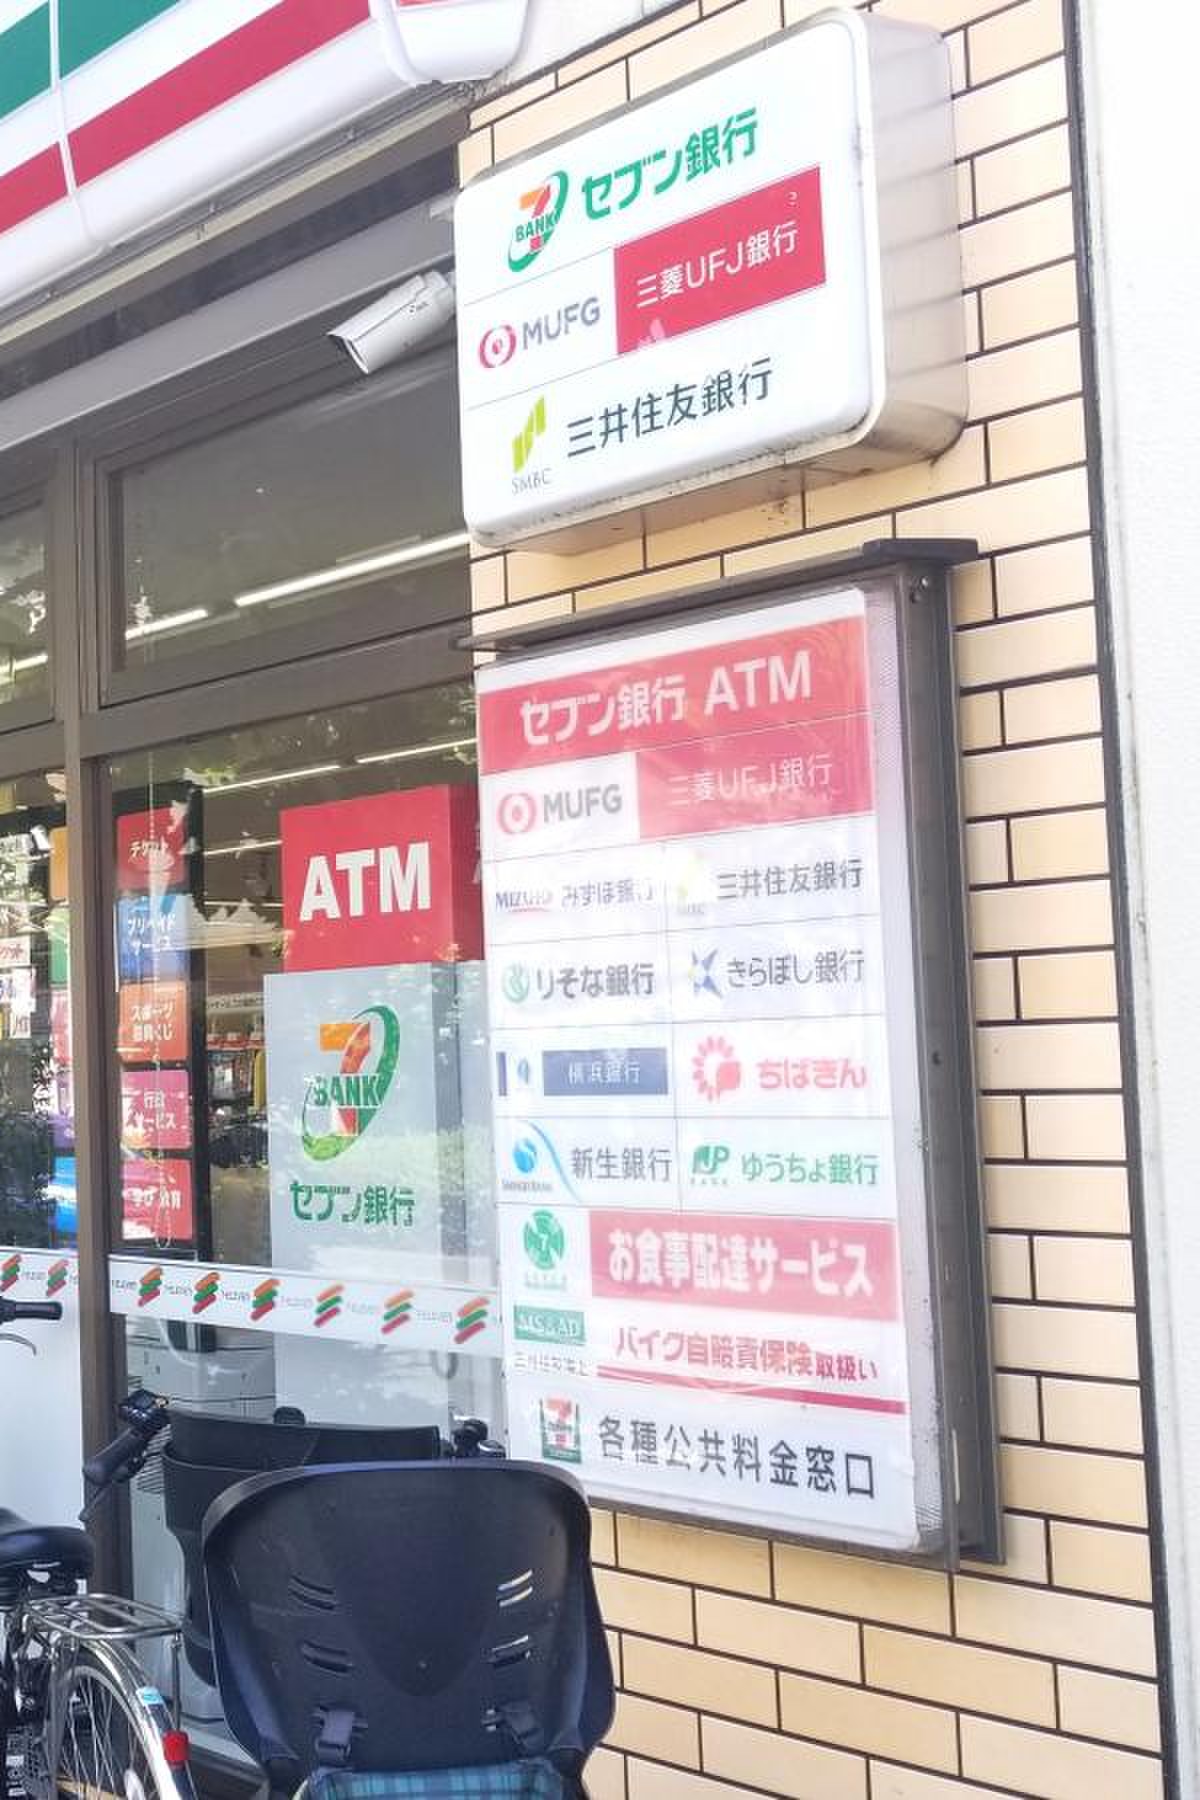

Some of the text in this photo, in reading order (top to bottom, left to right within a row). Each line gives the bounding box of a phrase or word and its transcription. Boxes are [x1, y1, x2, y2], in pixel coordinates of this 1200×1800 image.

[582, 107, 758, 221] セブン銀行
[516, 211, 558, 243] BANK
[637, 221, 799, 308] 三菱UFJ銀行
[522, 297, 601, 351] MUFG
[567, 357, 775, 458] 三井住友銀行
[511, 467, 553, 495] SMBC
[520, 650, 811, 746] セブン銀行 ATM
[667, 753, 832, 806] 三菱UFJ銀行
[543, 783, 623, 824] MUFG
[299, 841, 432, 923] ATM
[717, 859, 863, 900] 三井住友銀行
[535, 963, 655, 1000] りそな銀行
[727, 949, 865, 989] きらぼし銀行
[312, 1075, 381, 1107] BANK
[568, 1060, 641, 1085] 横浜銀行
[571, 1146, 673, 1183] 新生銀行
[741, 1151, 879, 1186] ゆうちょ銀行
[289, 1180, 415, 1227] セブン銀行
[608, 1228, 876, 1298] お食事配達サービス
[598, 1414, 876, 1499] 各種公共料金窓口
